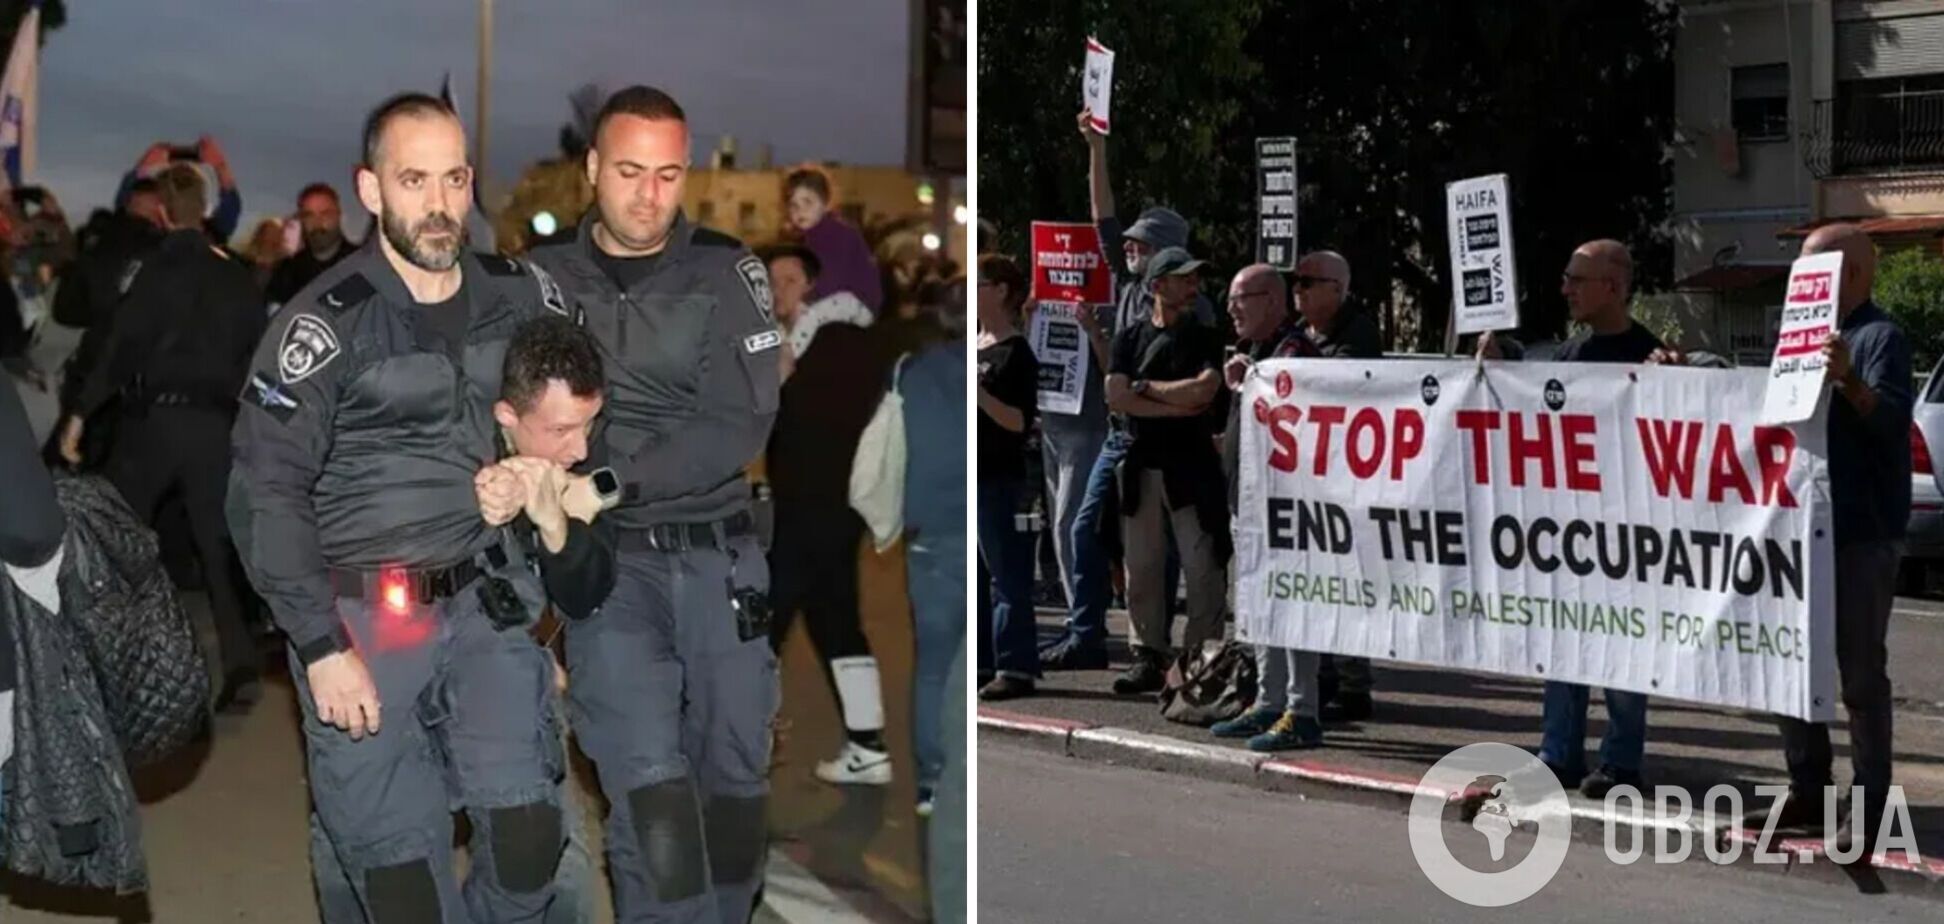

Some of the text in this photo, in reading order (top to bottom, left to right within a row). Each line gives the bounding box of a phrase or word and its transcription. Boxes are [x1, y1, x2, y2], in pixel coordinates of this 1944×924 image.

[1455, 189, 1498, 211] HAIFA
[1054, 233, 1071, 250] די
[1492, 254, 1505, 304] WAR
[1040, 303, 1078, 318] HAIF
[1267, 404, 1800, 508] STOP THE WAR
[1266, 497, 1804, 602] END THE OCCUPATION
[1266, 570, 1804, 662] ISRAELIS AND PALESTINIANS FOR PEACE
